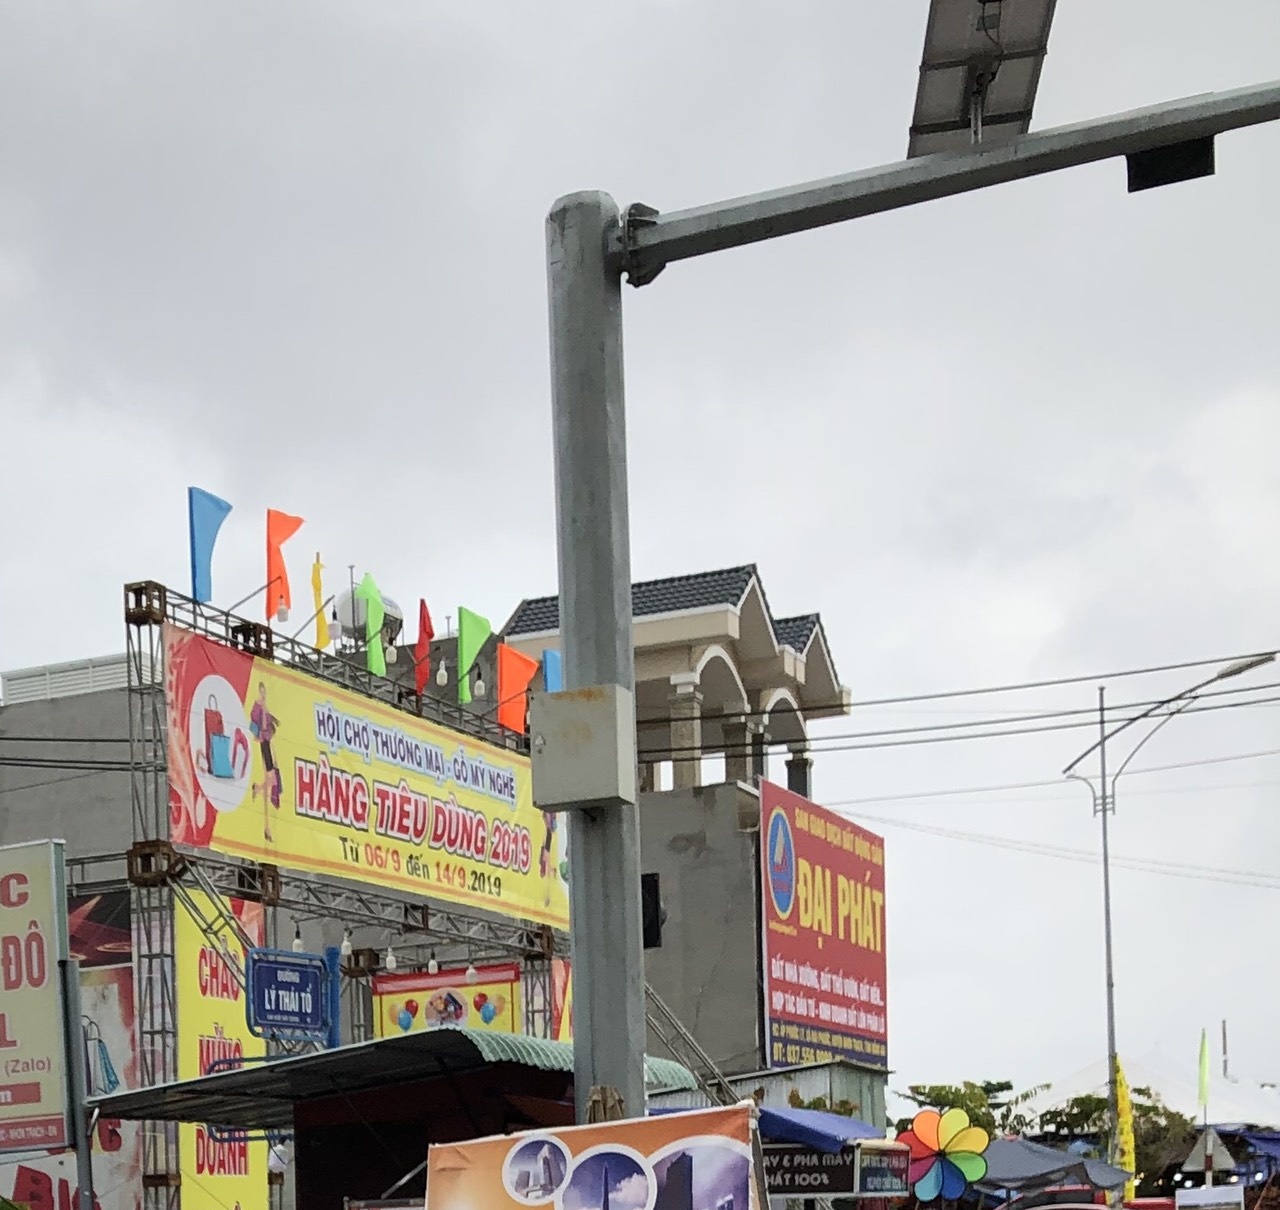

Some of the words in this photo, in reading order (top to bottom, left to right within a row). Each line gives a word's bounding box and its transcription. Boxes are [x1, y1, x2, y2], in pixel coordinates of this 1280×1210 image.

[316, 707, 340, 747] HỘI
[343, 721, 370, 758] CHỢ
[373, 729, 421, 772] THƯƠNG
[424, 747, 445, 781] MẠI
[296, 753, 369, 831] HÀNG
[374, 780, 428, 844] TIÊU
[429, 794, 488, 861] DÙNG
[490, 819, 532, 874] 2019
[363, 844, 401, 872] 06/9
[406, 854, 430, 880] đến
[796, 857, 833, 950] ĐẠI
[837, 870, 883, 954] PHÁT
[0, 919, 46, 992] ĐÔ
[264, 984, 277, 1011] LÝ
[278, 985, 299, 1013] THÁI
[4, 1055, 52, 1078] (Zalo)
[763, 1154, 780, 1167] AY
[793, 1153, 819, 1167] PHA
